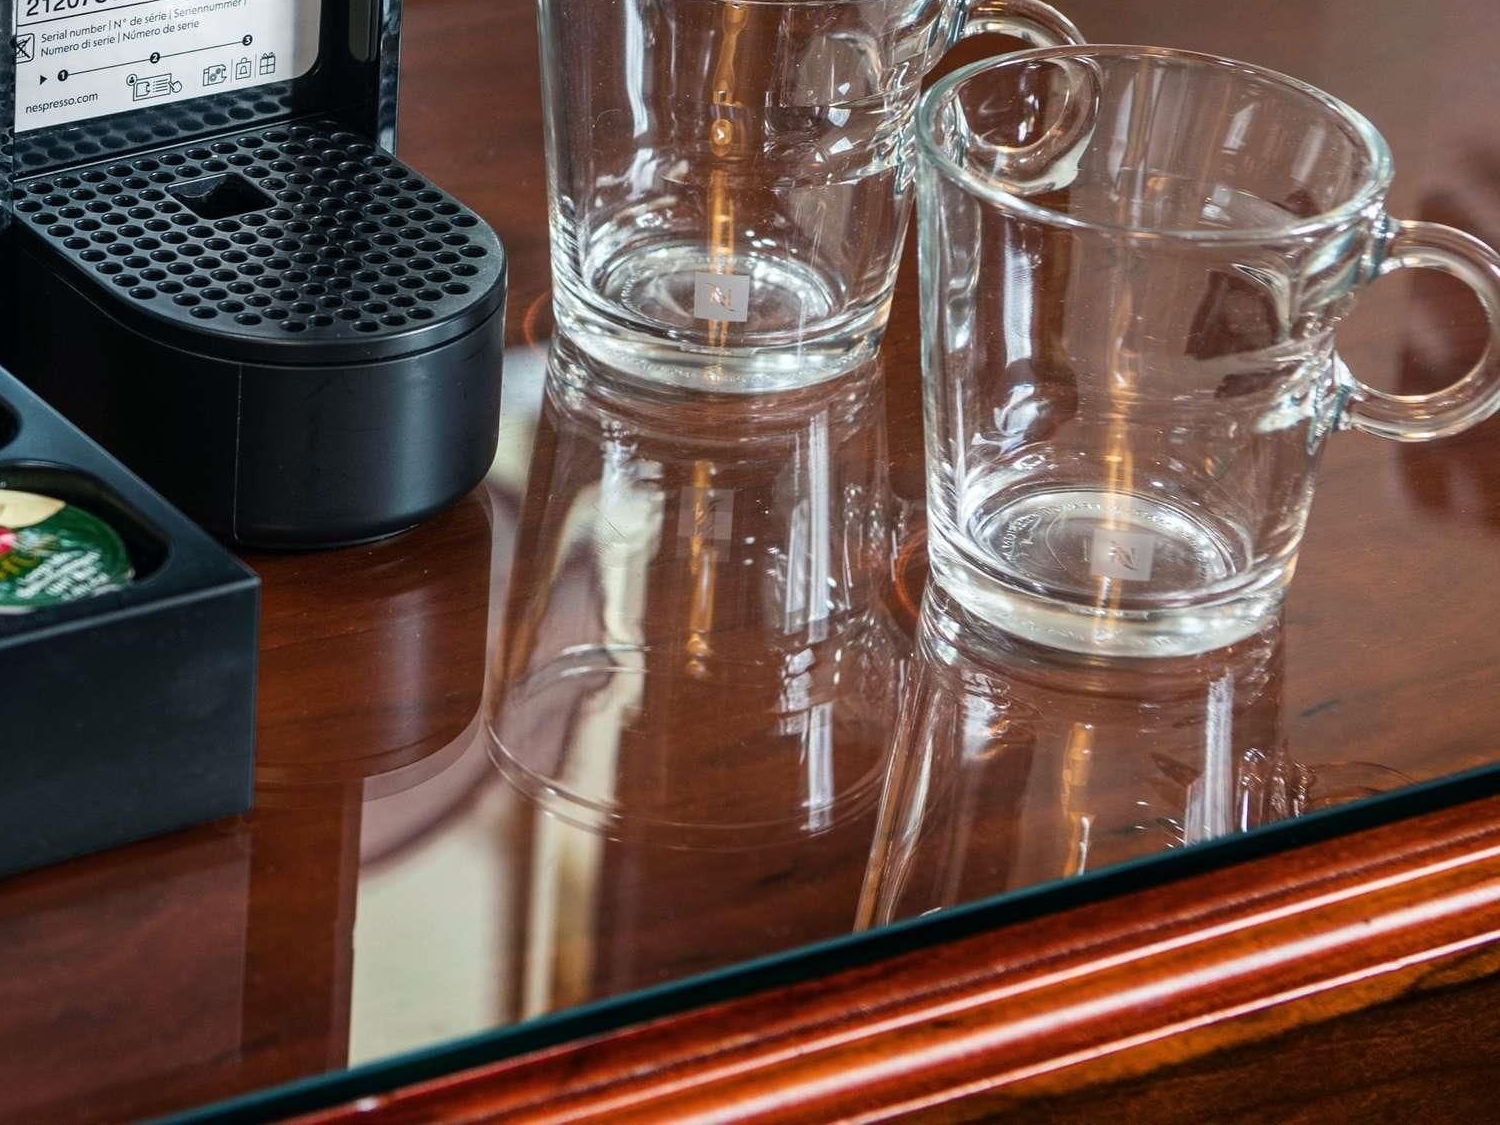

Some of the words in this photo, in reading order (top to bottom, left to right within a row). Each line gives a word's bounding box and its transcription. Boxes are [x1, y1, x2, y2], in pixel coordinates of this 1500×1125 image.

[38, 26, 68, 43] Serial
[68, 18, 107, 38] number
[129, 14, 143, 26] de
[40, 38, 79, 57] Numero
[80, 38, 92, 49] di
[91, 35, 115, 47] serie
[162, 23, 175, 33] de
[177, 20, 199, 31] serie
[25, 90, 99, 114] nespresso.com
